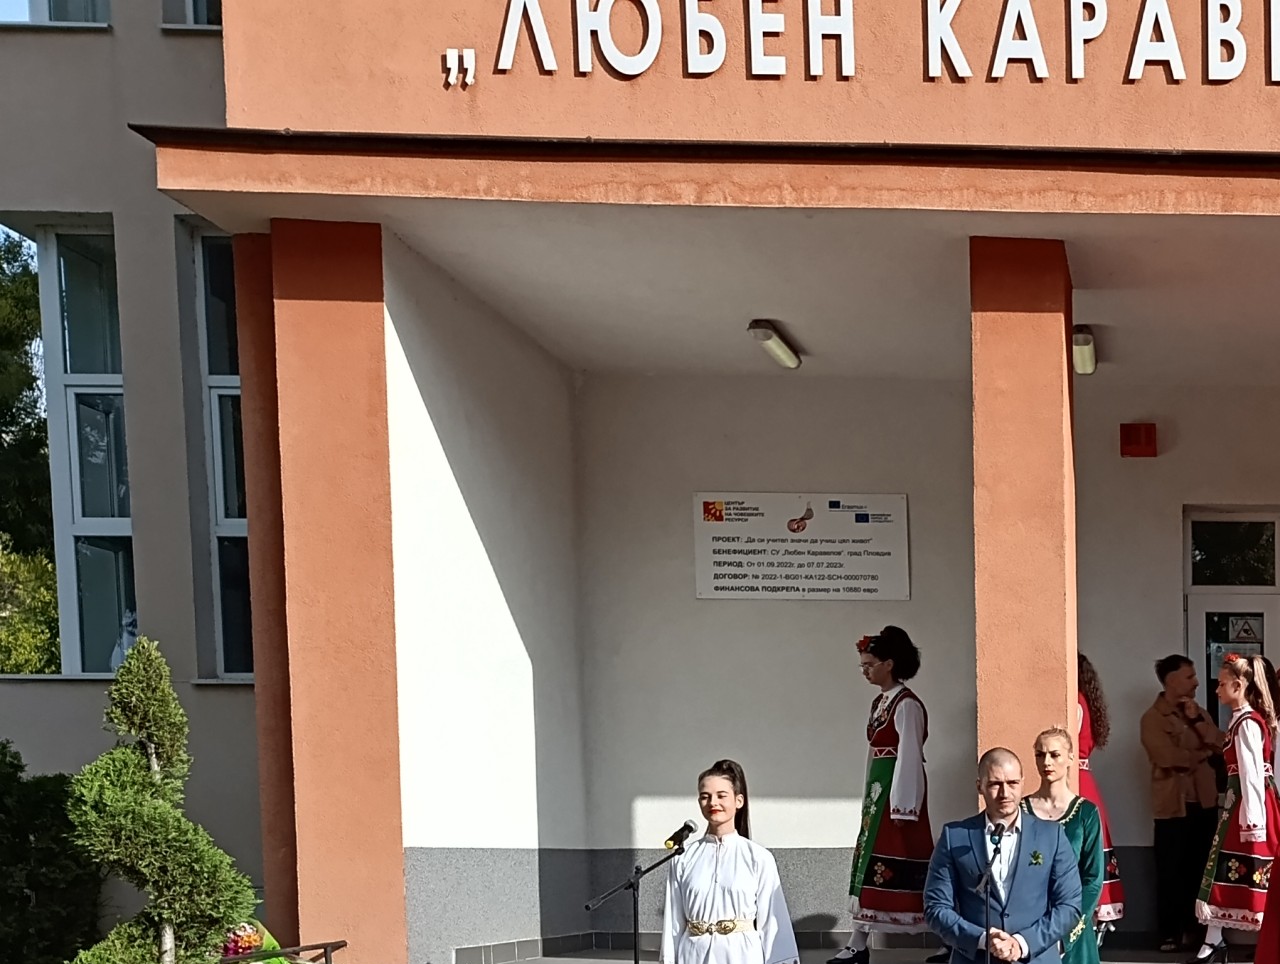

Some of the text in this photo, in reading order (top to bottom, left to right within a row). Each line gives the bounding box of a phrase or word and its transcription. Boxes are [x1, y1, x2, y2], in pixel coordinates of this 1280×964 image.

[712, 548, 769, 556] БЕНЕФИЦИЕНТ:
[863, 549, 892, 557] Пловдив
[761, 585, 801, 593] ПОДКРЕПА
